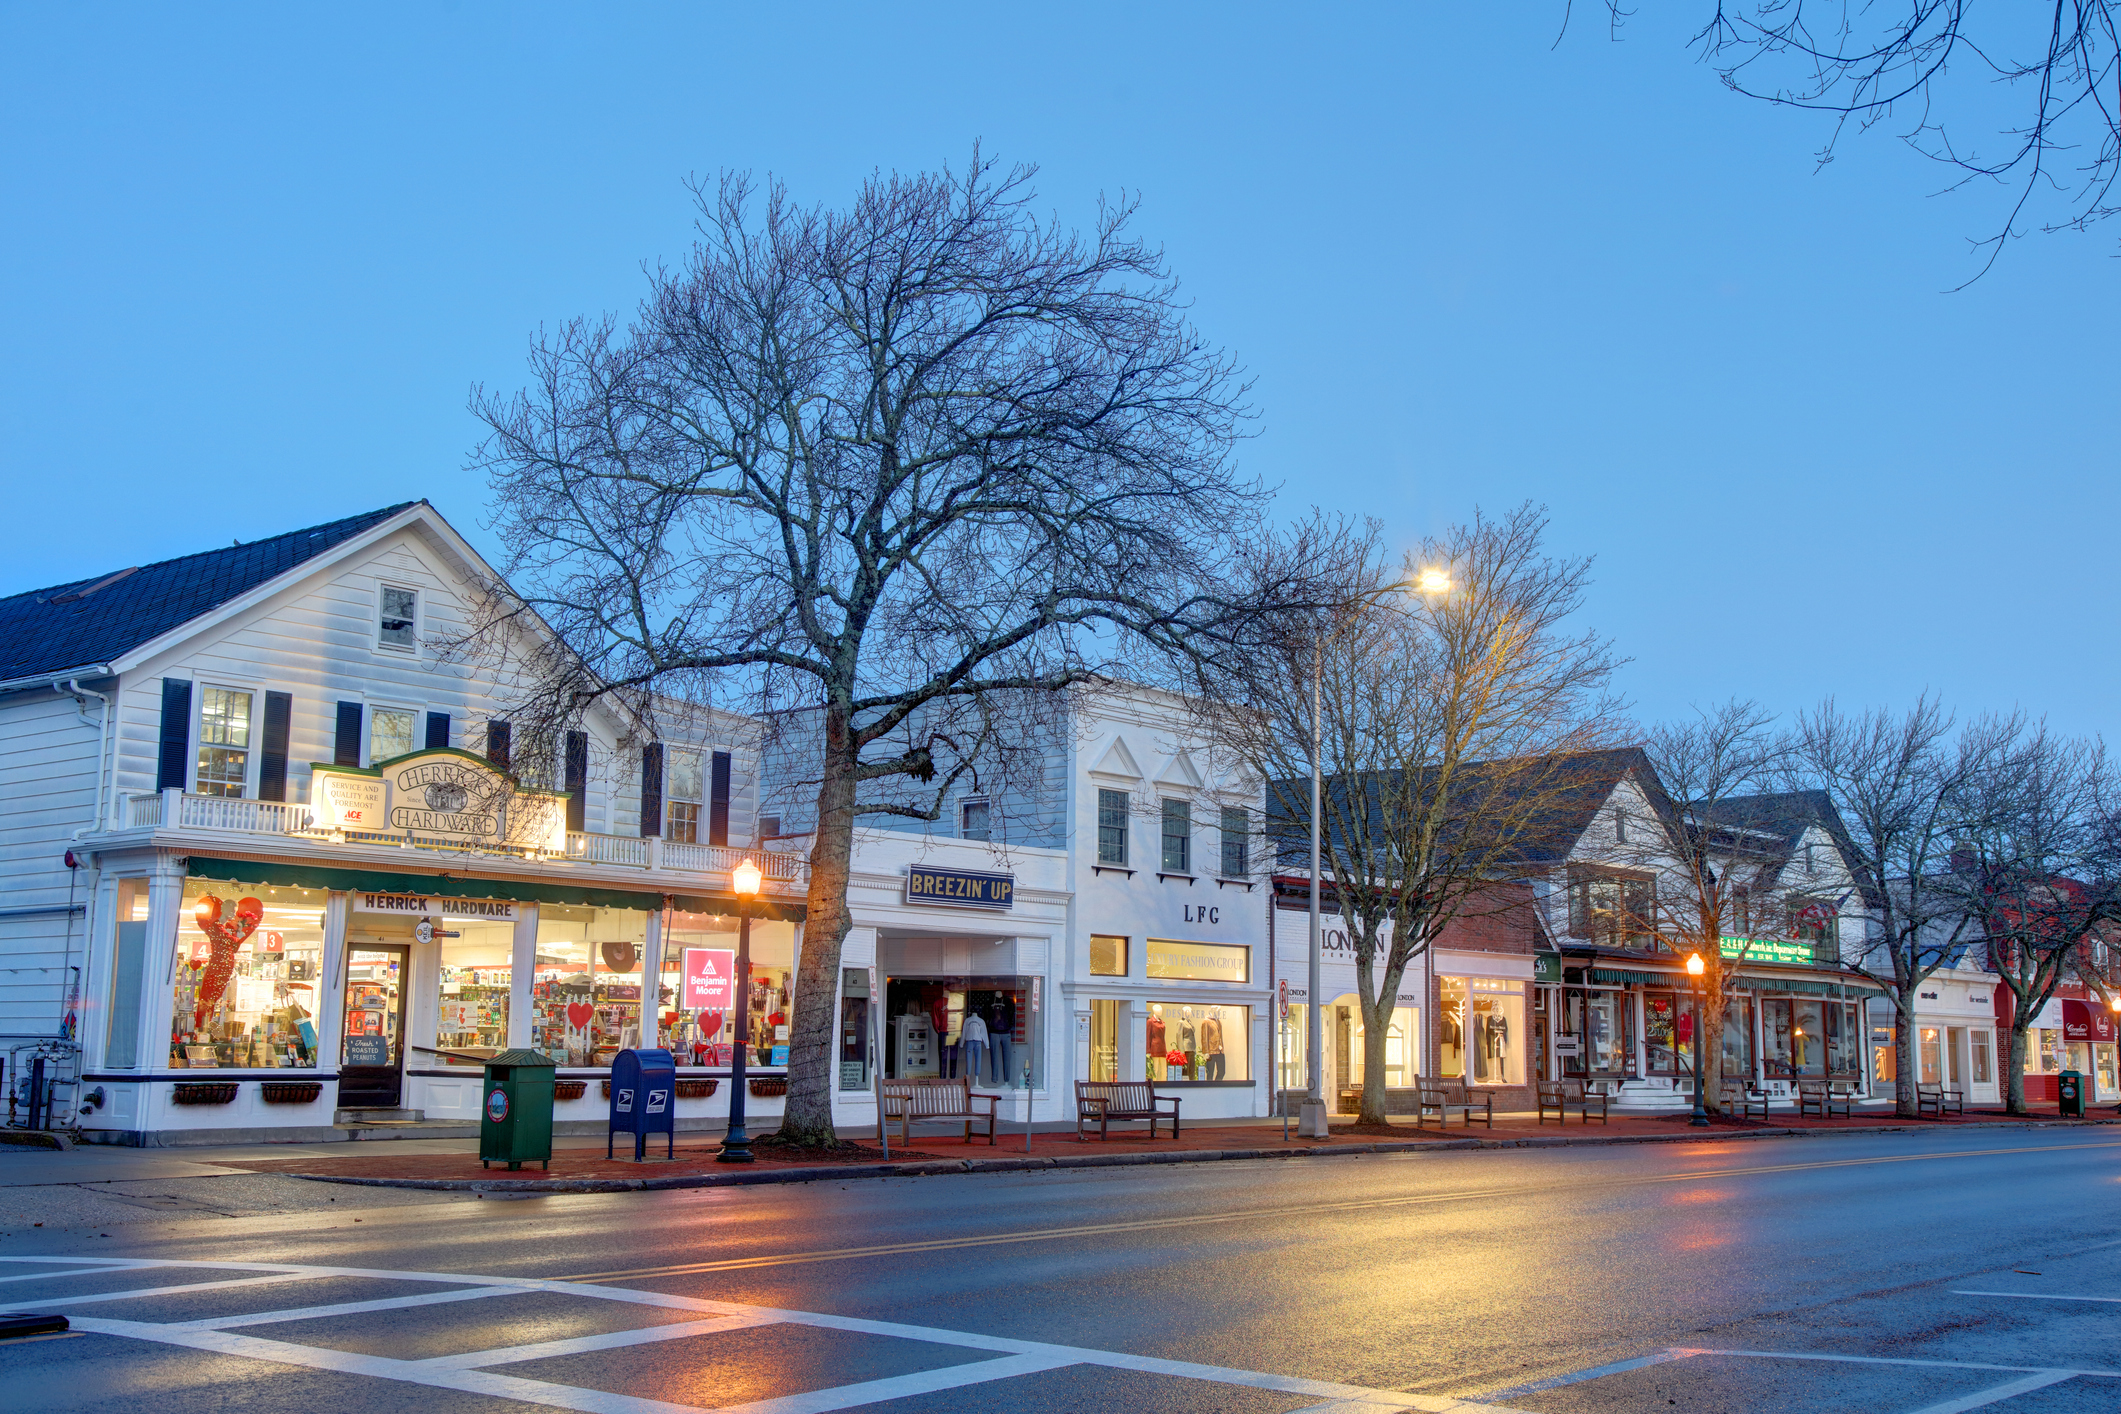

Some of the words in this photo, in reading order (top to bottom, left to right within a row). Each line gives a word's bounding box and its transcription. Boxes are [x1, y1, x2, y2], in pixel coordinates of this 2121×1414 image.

[405, 766, 487, 795] HERRICK
[331, 781, 361, 791] SERVICE
[363, 785, 379, 793] AND
[331, 790, 362, 800] QUALITY
[364, 794, 379, 802] ARE
[406, 795, 421, 803] Since
[334, 799, 374, 809] FOREMOST
[344, 809, 362, 819] ACE
[397, 809, 492, 834] HARDWARE
[911, 873, 988, 898] BREEZIN'
[990, 881, 1012, 900] UP
[365, 894, 428, 911] HERRICK
[442, 899, 512, 917] HARDWARE
[1321, 929, 1385, 953] LONN
[1181, 954, 1216, 968] FASHION
[1216, 956, 1244, 970] GROUP
[1321, 951, 1385, 961] JEWERS
[691, 976, 727, 987] Benjamin
[1166, 1009, 1206, 1019] DESIGNER
[1208, 1010, 1227, 1020] SALE
[354, 1039, 374, 1047] Fresh
